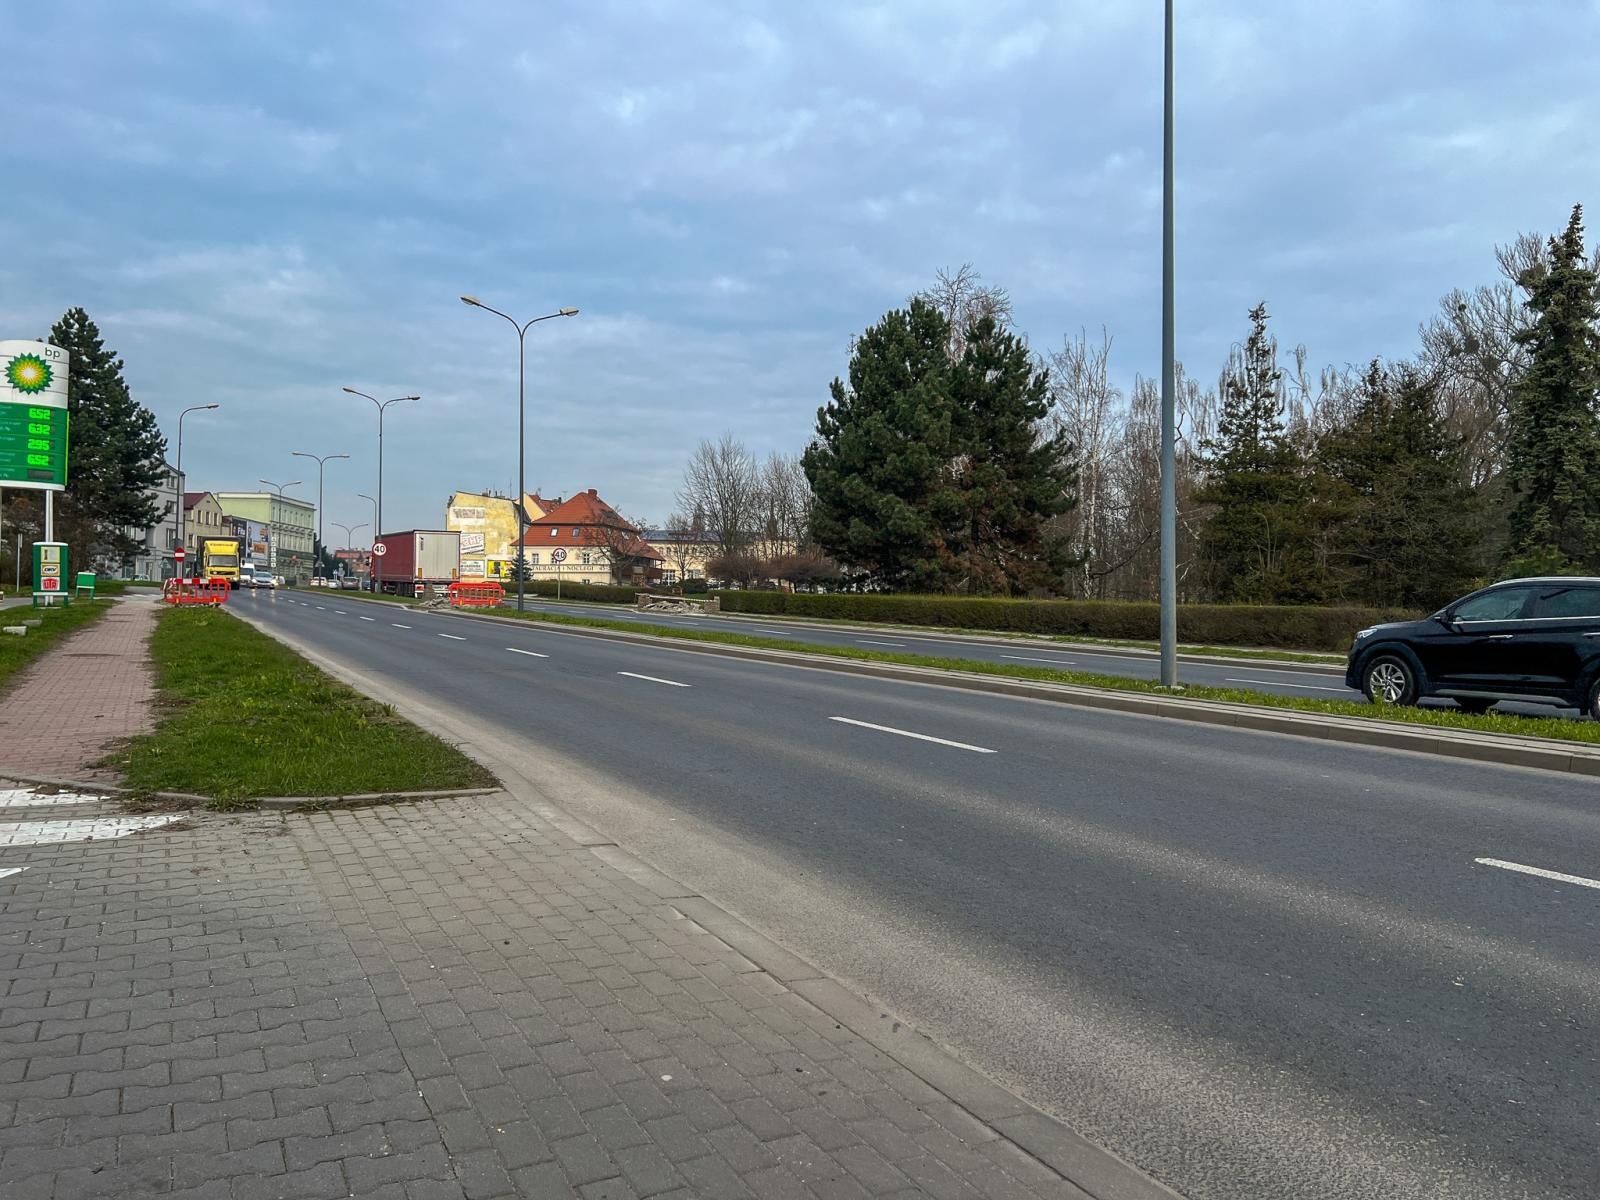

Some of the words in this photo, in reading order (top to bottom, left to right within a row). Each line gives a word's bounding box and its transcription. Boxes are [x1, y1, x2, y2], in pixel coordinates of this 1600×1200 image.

[45, 346, 60, 360] bp
[374, 545, 385, 553] 40
[555, 551, 565, 560] 40
